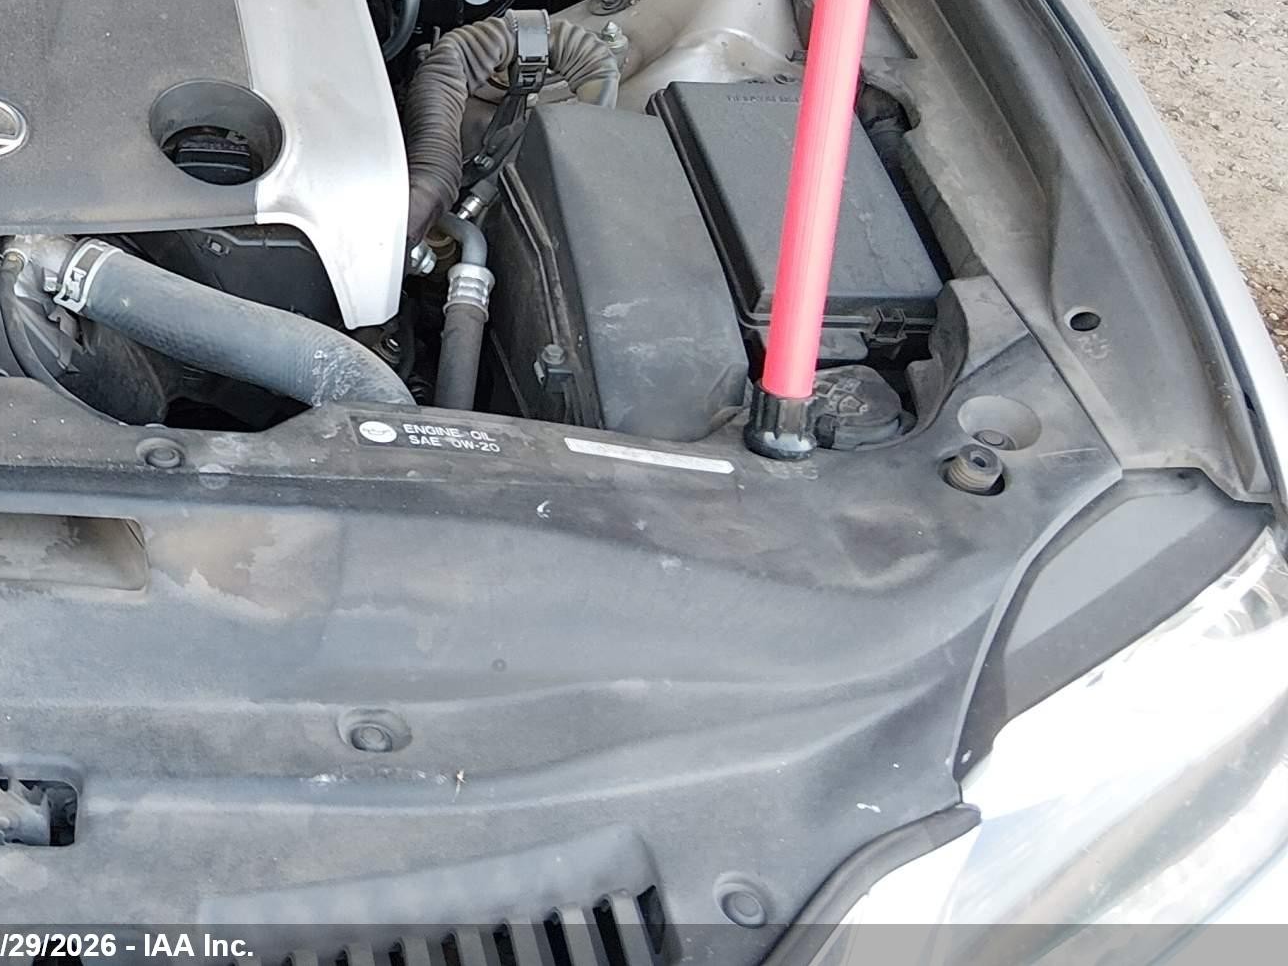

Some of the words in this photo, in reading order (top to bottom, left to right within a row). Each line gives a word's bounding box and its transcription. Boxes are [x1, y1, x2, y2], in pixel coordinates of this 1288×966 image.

[403, 423, 464, 438] ENGINE
[470, 430, 497, 442] OIL
[408, 434, 443, 447] SAE
[451, 439, 501, 453] 0W-20
